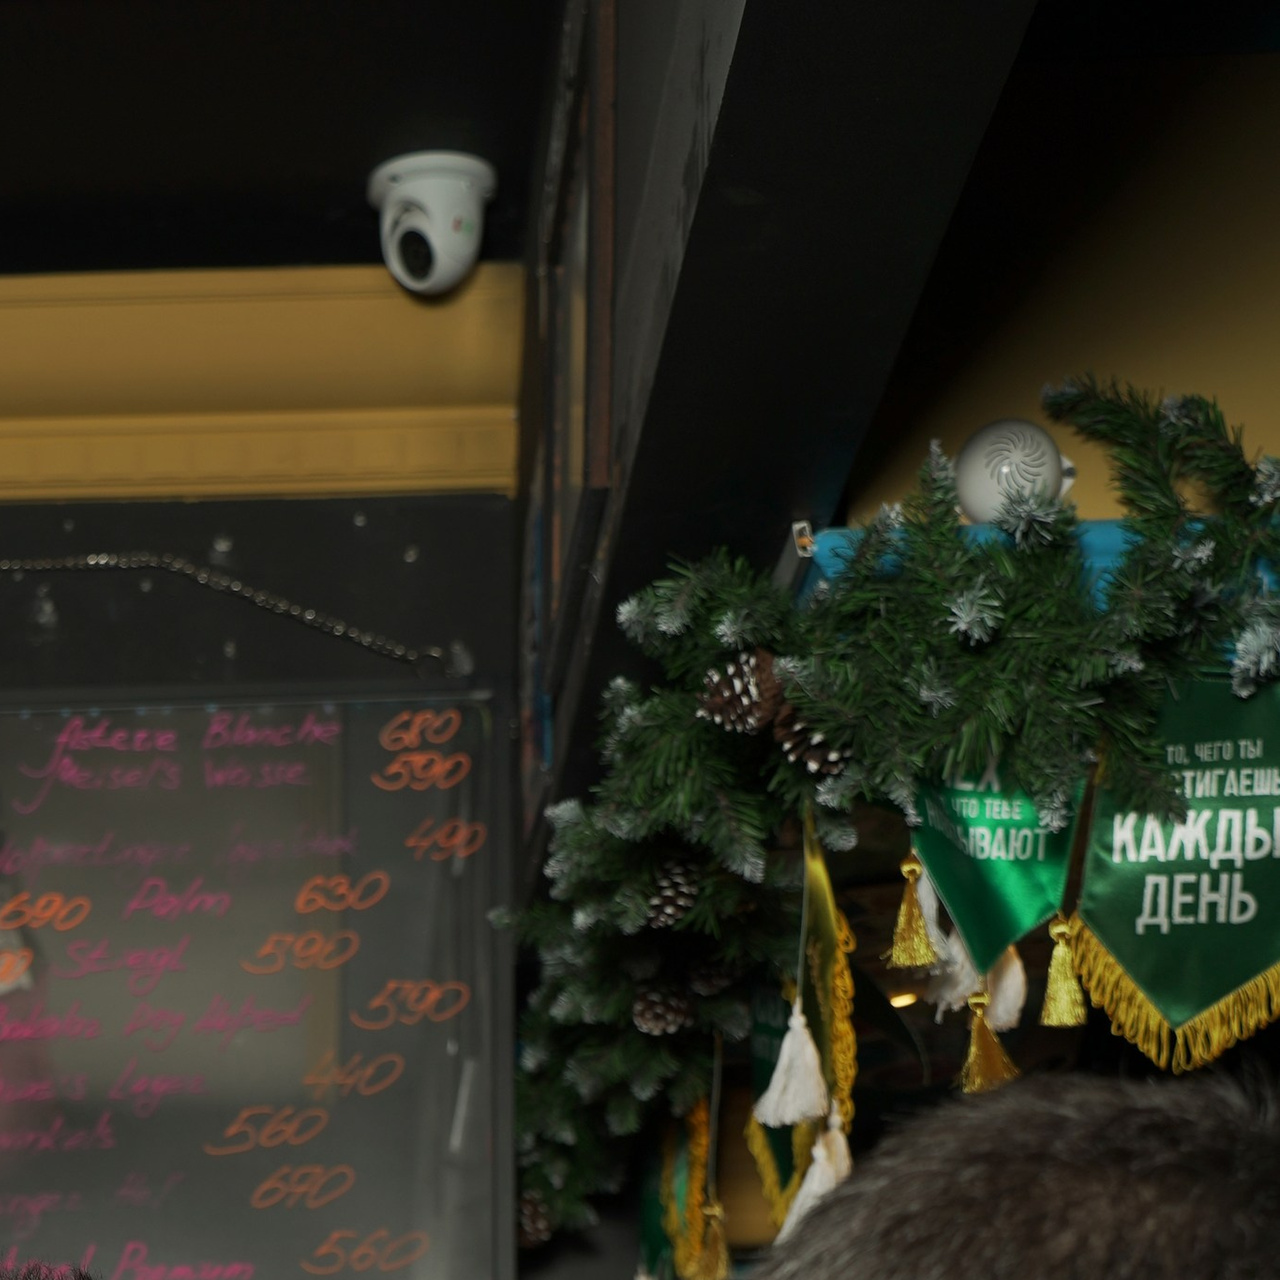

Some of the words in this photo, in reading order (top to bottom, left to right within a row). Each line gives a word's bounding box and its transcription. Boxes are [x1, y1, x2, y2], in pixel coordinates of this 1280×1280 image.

[371, 749, 471, 792] 590
[1166, 744, 1190, 765] ТО,
[1194, 740, 1234, 761] ЧЕГО
[1238, 738, 1264, 760] ТЫ
[404, 817, 488, 862] 490
[295, 870, 390, 914] 630
[1136, 873, 1258, 935] ДЕНЬ
[239, 929, 360, 975] 590
[349, 979, 471, 1030] 590
[204, 1105, 328, 1155] 560
[299, 1229, 431, 1275] 560
